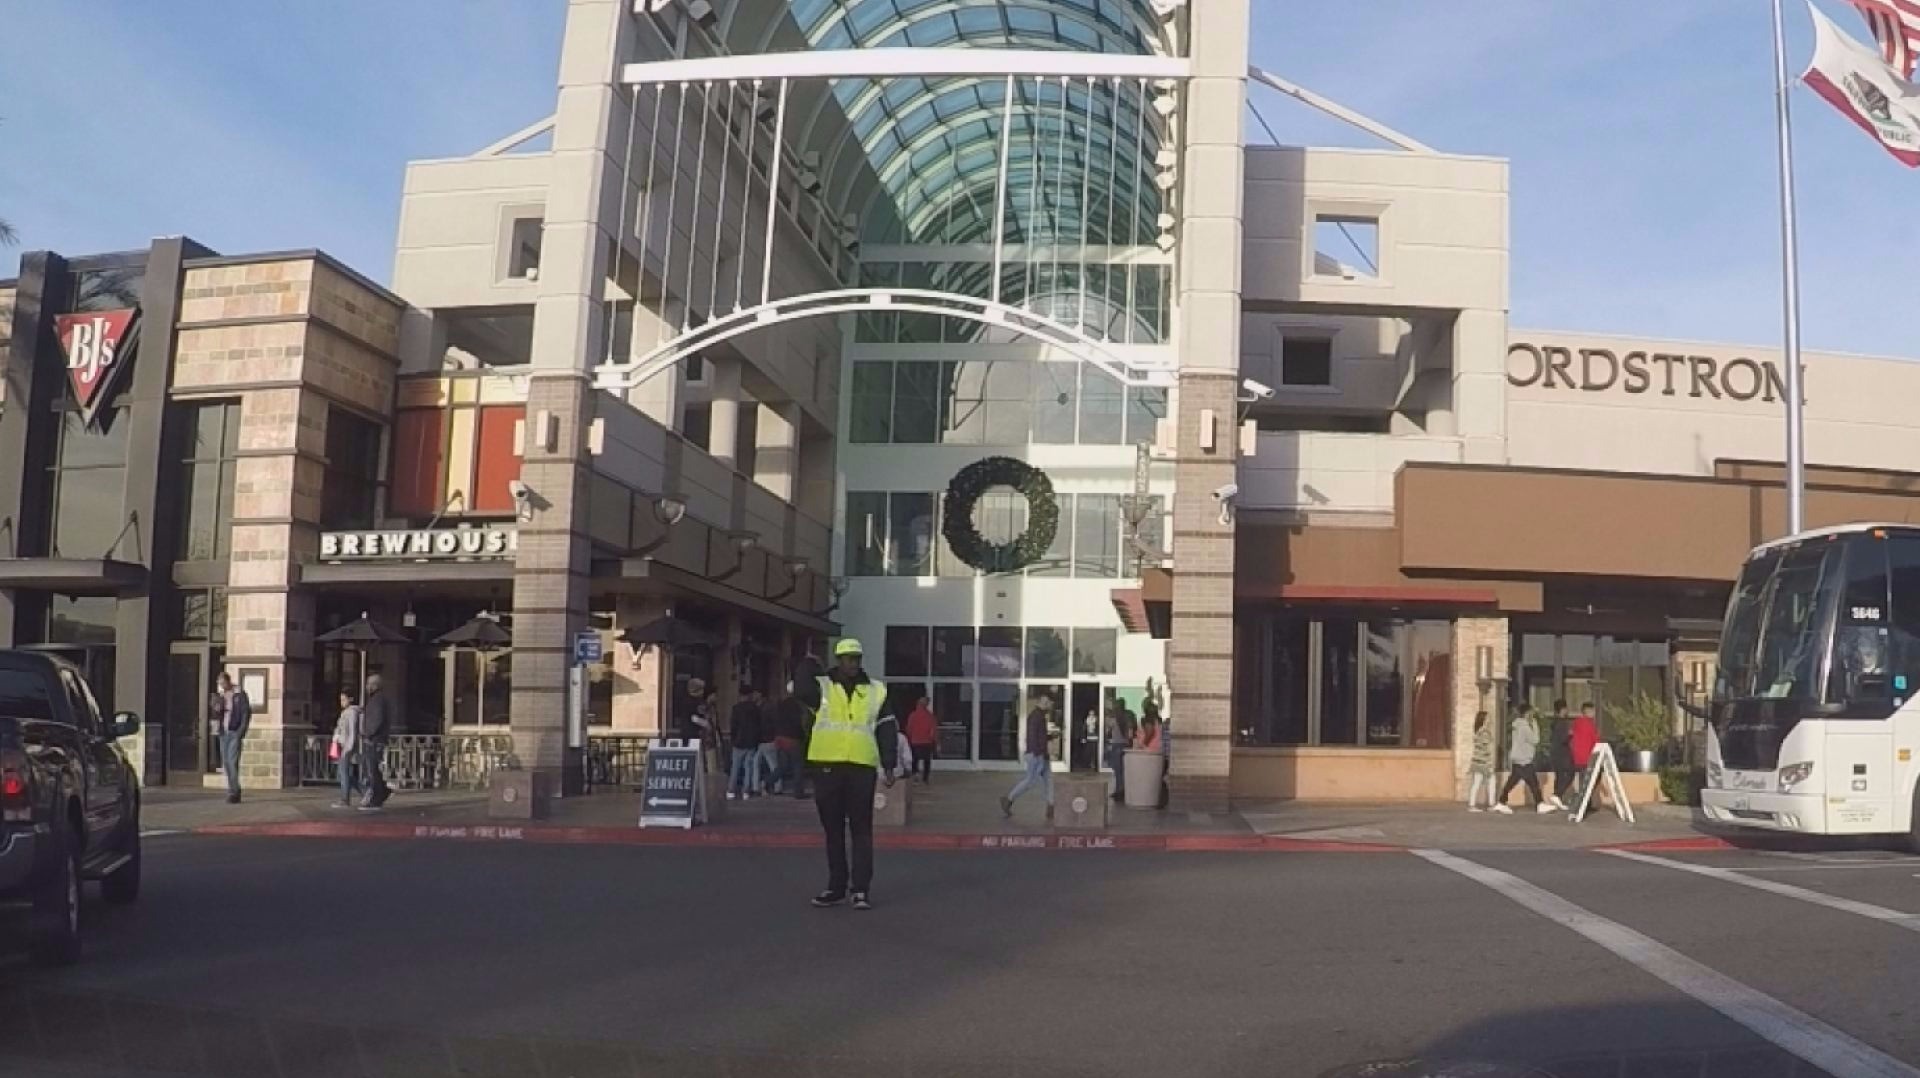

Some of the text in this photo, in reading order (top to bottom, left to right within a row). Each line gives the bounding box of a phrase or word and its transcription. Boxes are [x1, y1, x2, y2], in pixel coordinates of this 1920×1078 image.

[66, 317, 115, 384] BJ's
[1507, 342, 1807, 406] ORDSTROM
[647, 776, 692, 790] SERVICE
[654, 759, 689, 772] VALET
